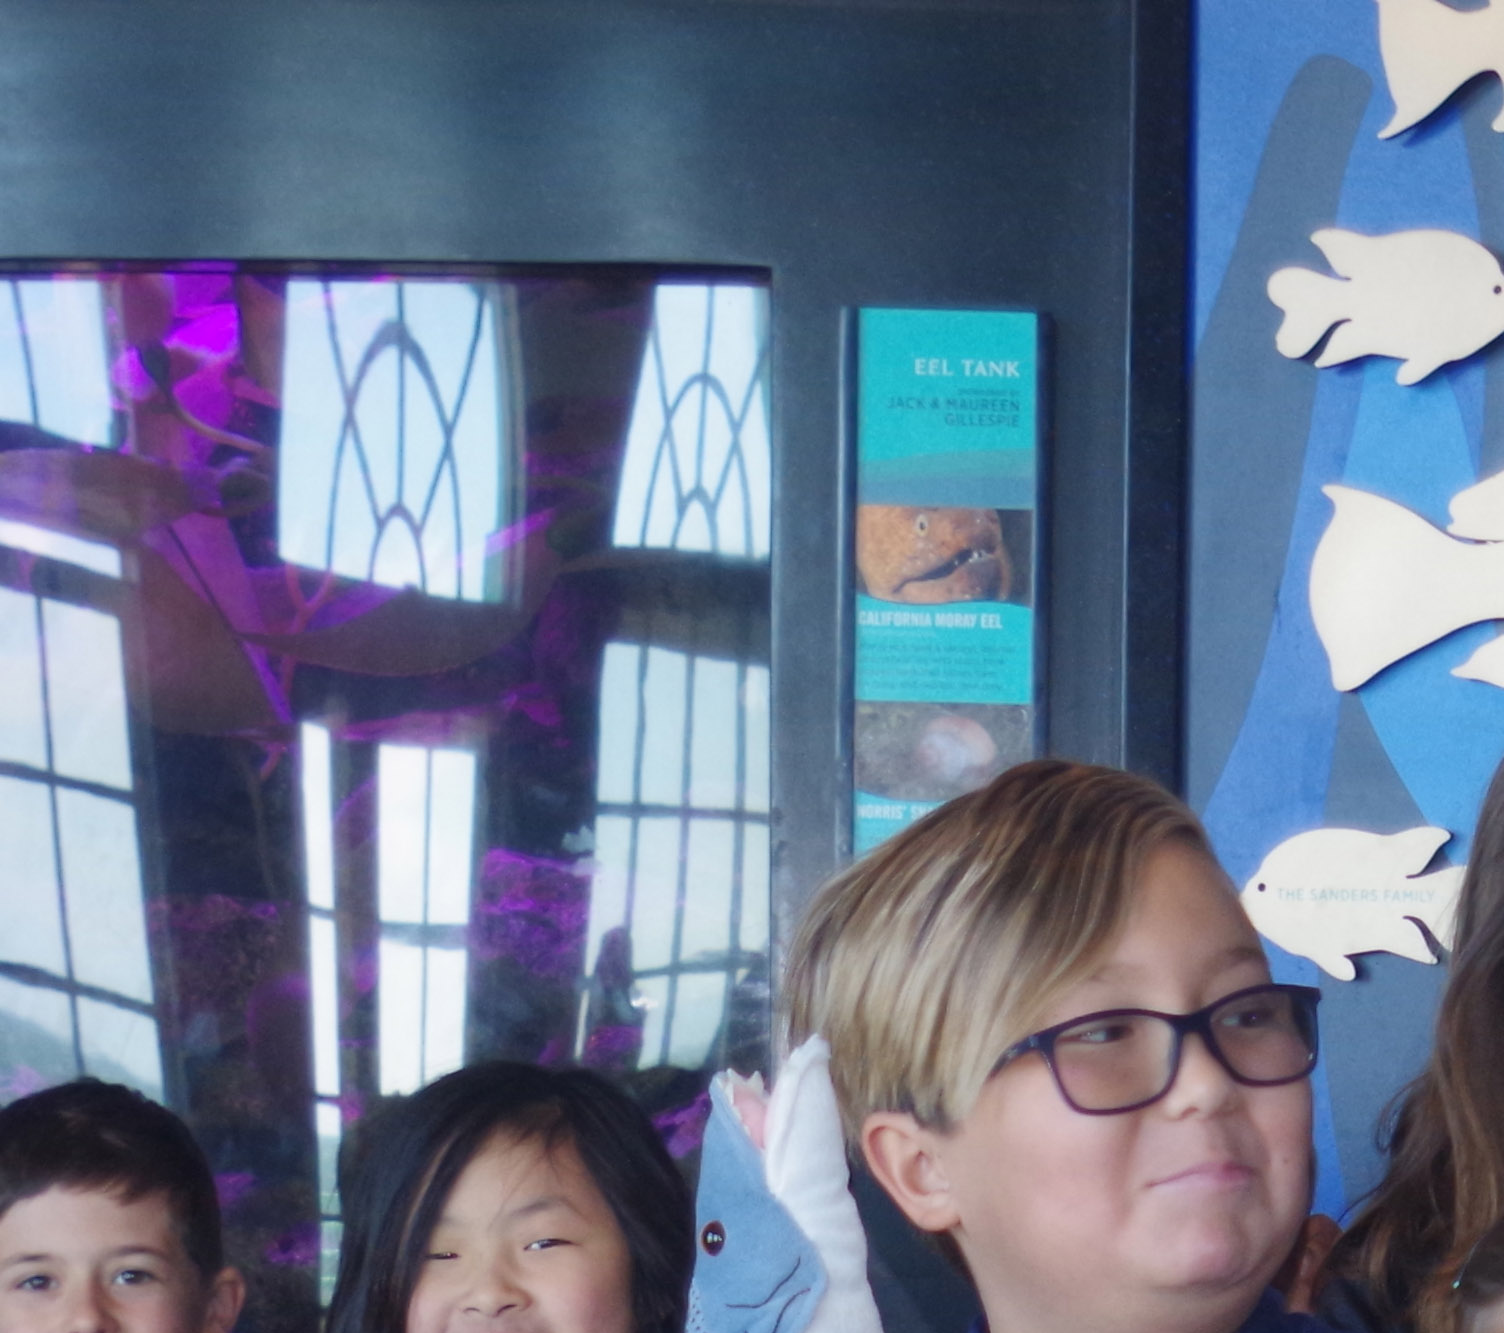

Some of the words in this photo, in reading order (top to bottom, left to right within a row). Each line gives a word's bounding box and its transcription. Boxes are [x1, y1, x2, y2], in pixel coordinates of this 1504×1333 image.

[914, 358, 954, 376] EEL
[961, 359, 1020, 378] TANK
[887, 397, 927, 410] JACK
[946, 398, 1020, 412] MAUREEN
[945, 413, 1019, 428] GILLESPIE
[857, 610, 932, 627] CALIFORNIA
[935, 612, 977, 629] MORAY
[980, 613, 1003, 629] EEL
[1277, 888, 1304, 902] THE
[1310, 888, 1378, 902] SANDERS
[1383, 888, 1436, 902] FAMILY
